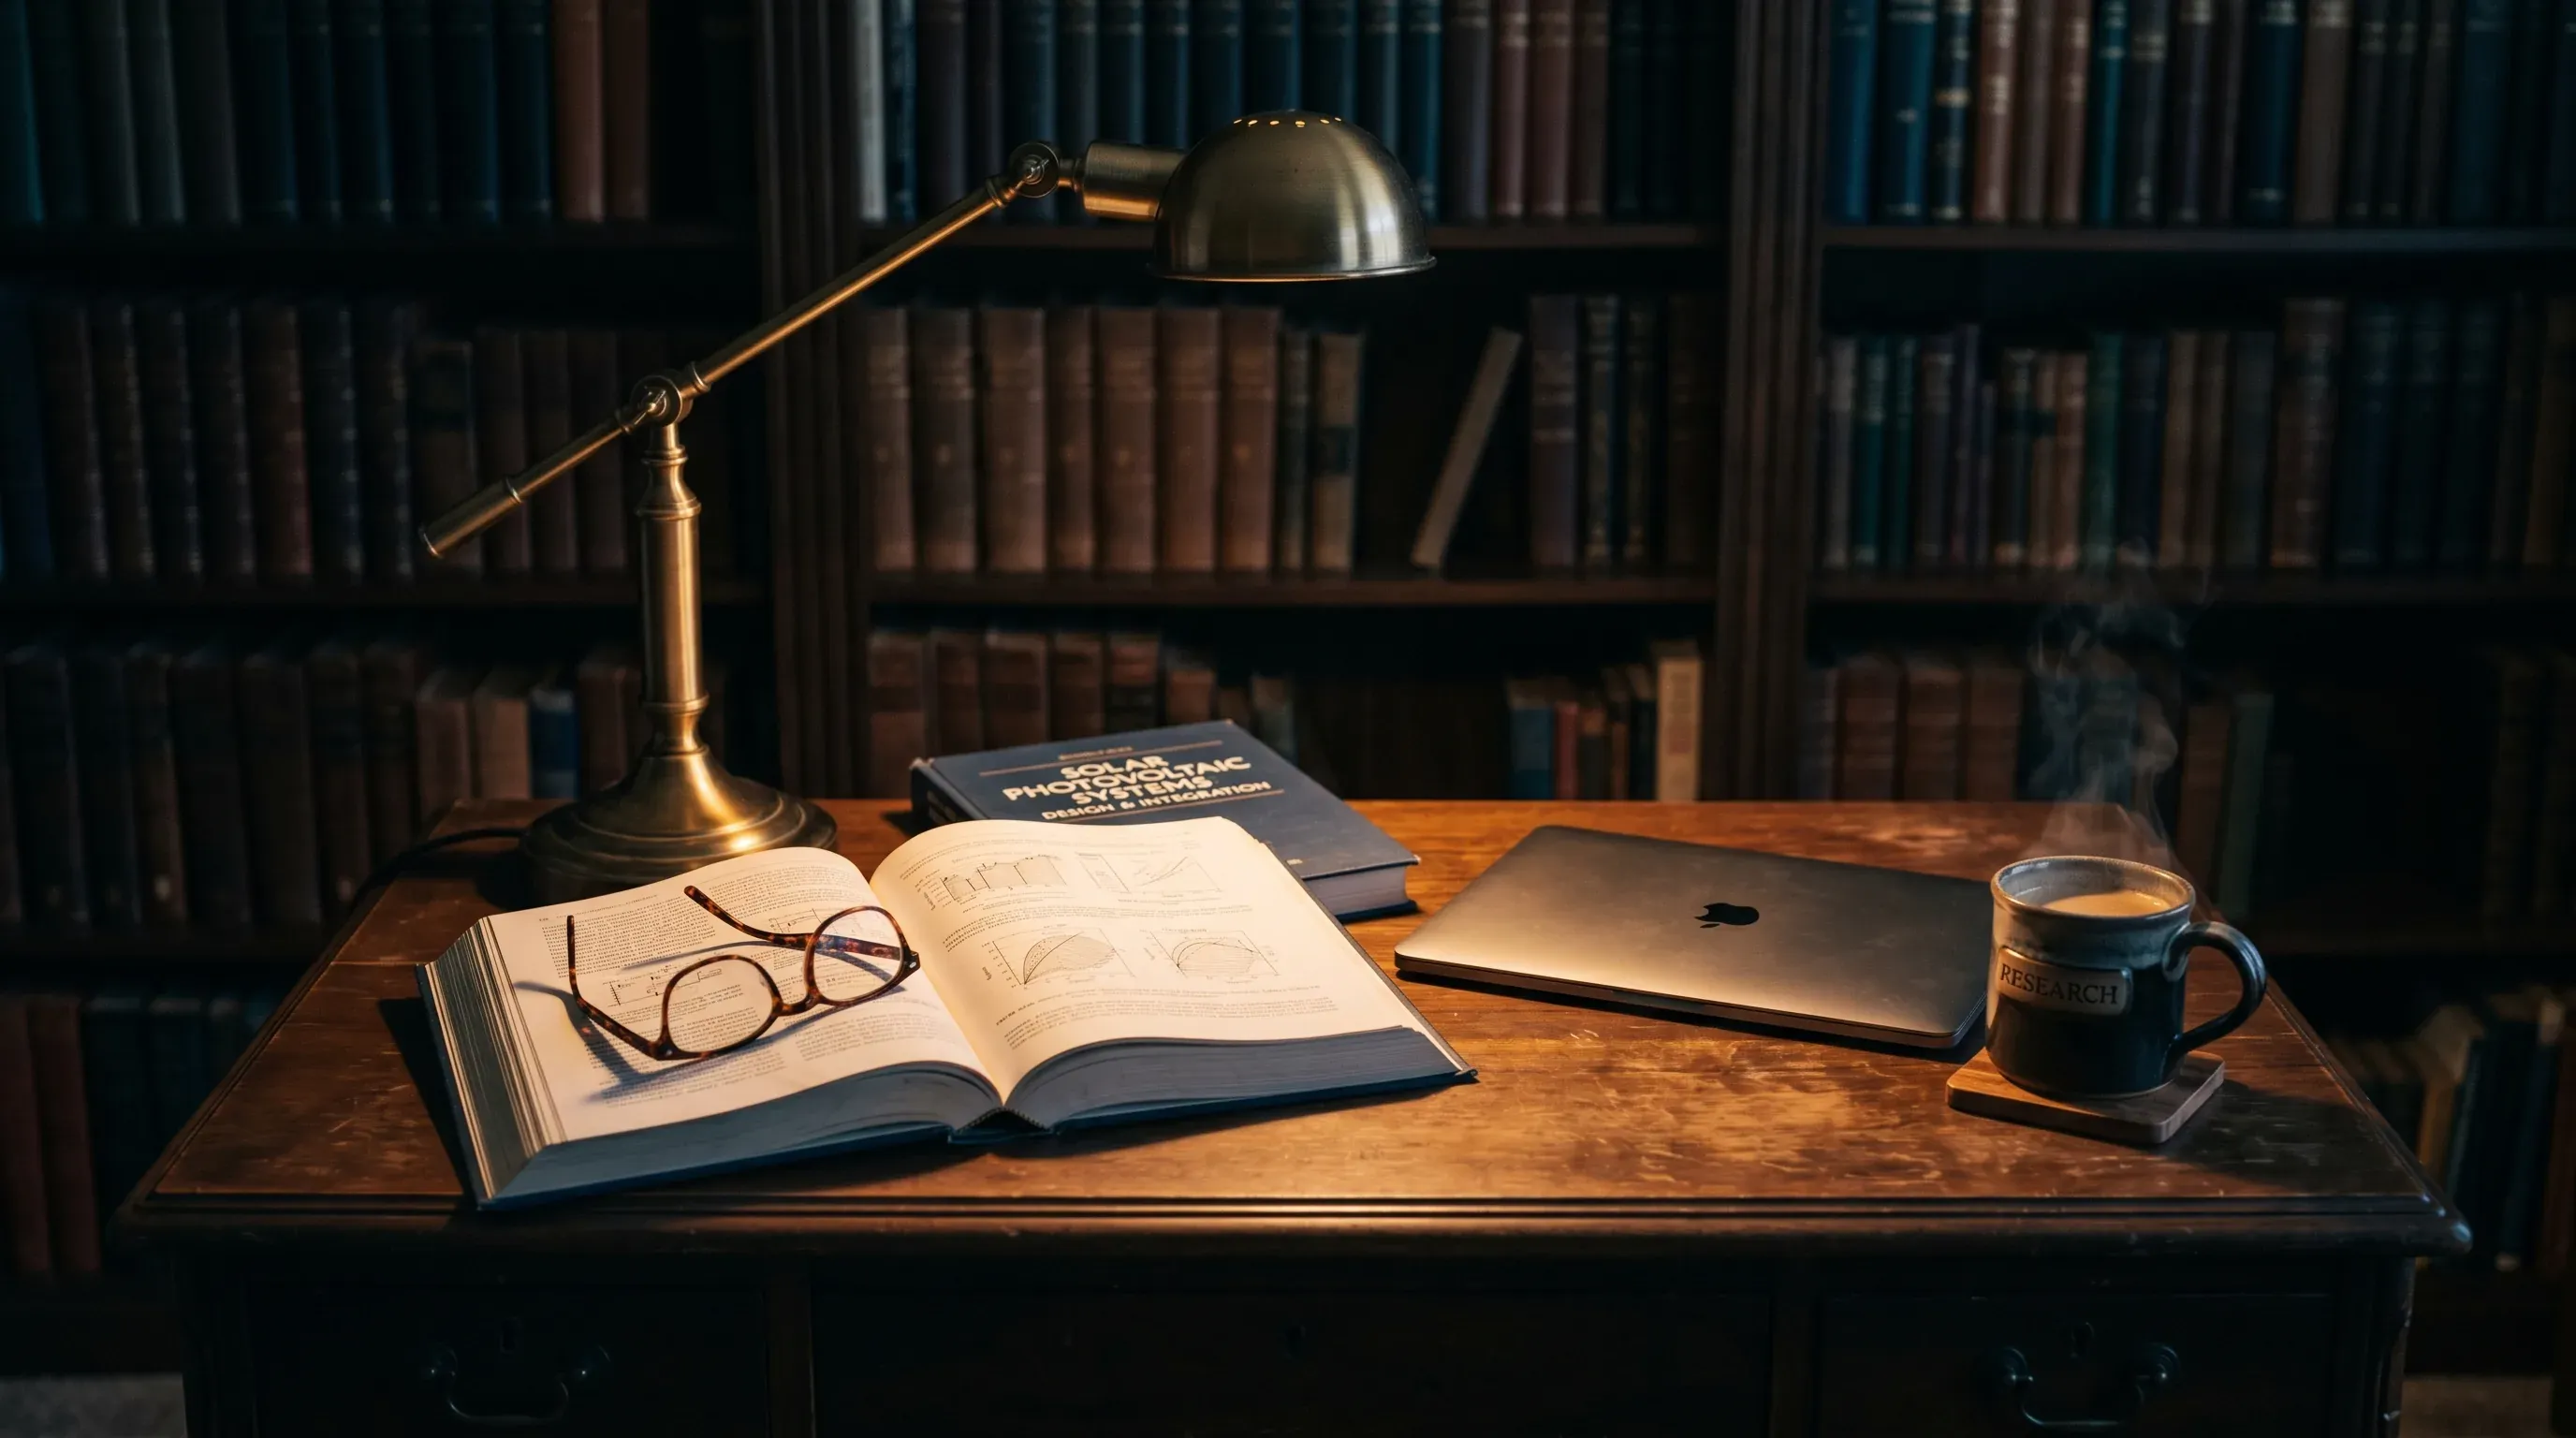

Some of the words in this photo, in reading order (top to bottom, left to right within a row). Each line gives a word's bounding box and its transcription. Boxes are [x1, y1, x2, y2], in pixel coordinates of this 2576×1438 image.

[1003, 756, 1251, 800] PHOTOVOLTAIC
[1061, 756, 1169, 780] SOLAR
[1041, 803, 1116, 820] DESIGN
[1120, 800, 1135, 810] &
[1138, 781, 1272, 807] INTEGRATION
[1071, 775, 1213, 805] SYSTEMS
[1999, 963, 2118, 1005] RESEARCH
